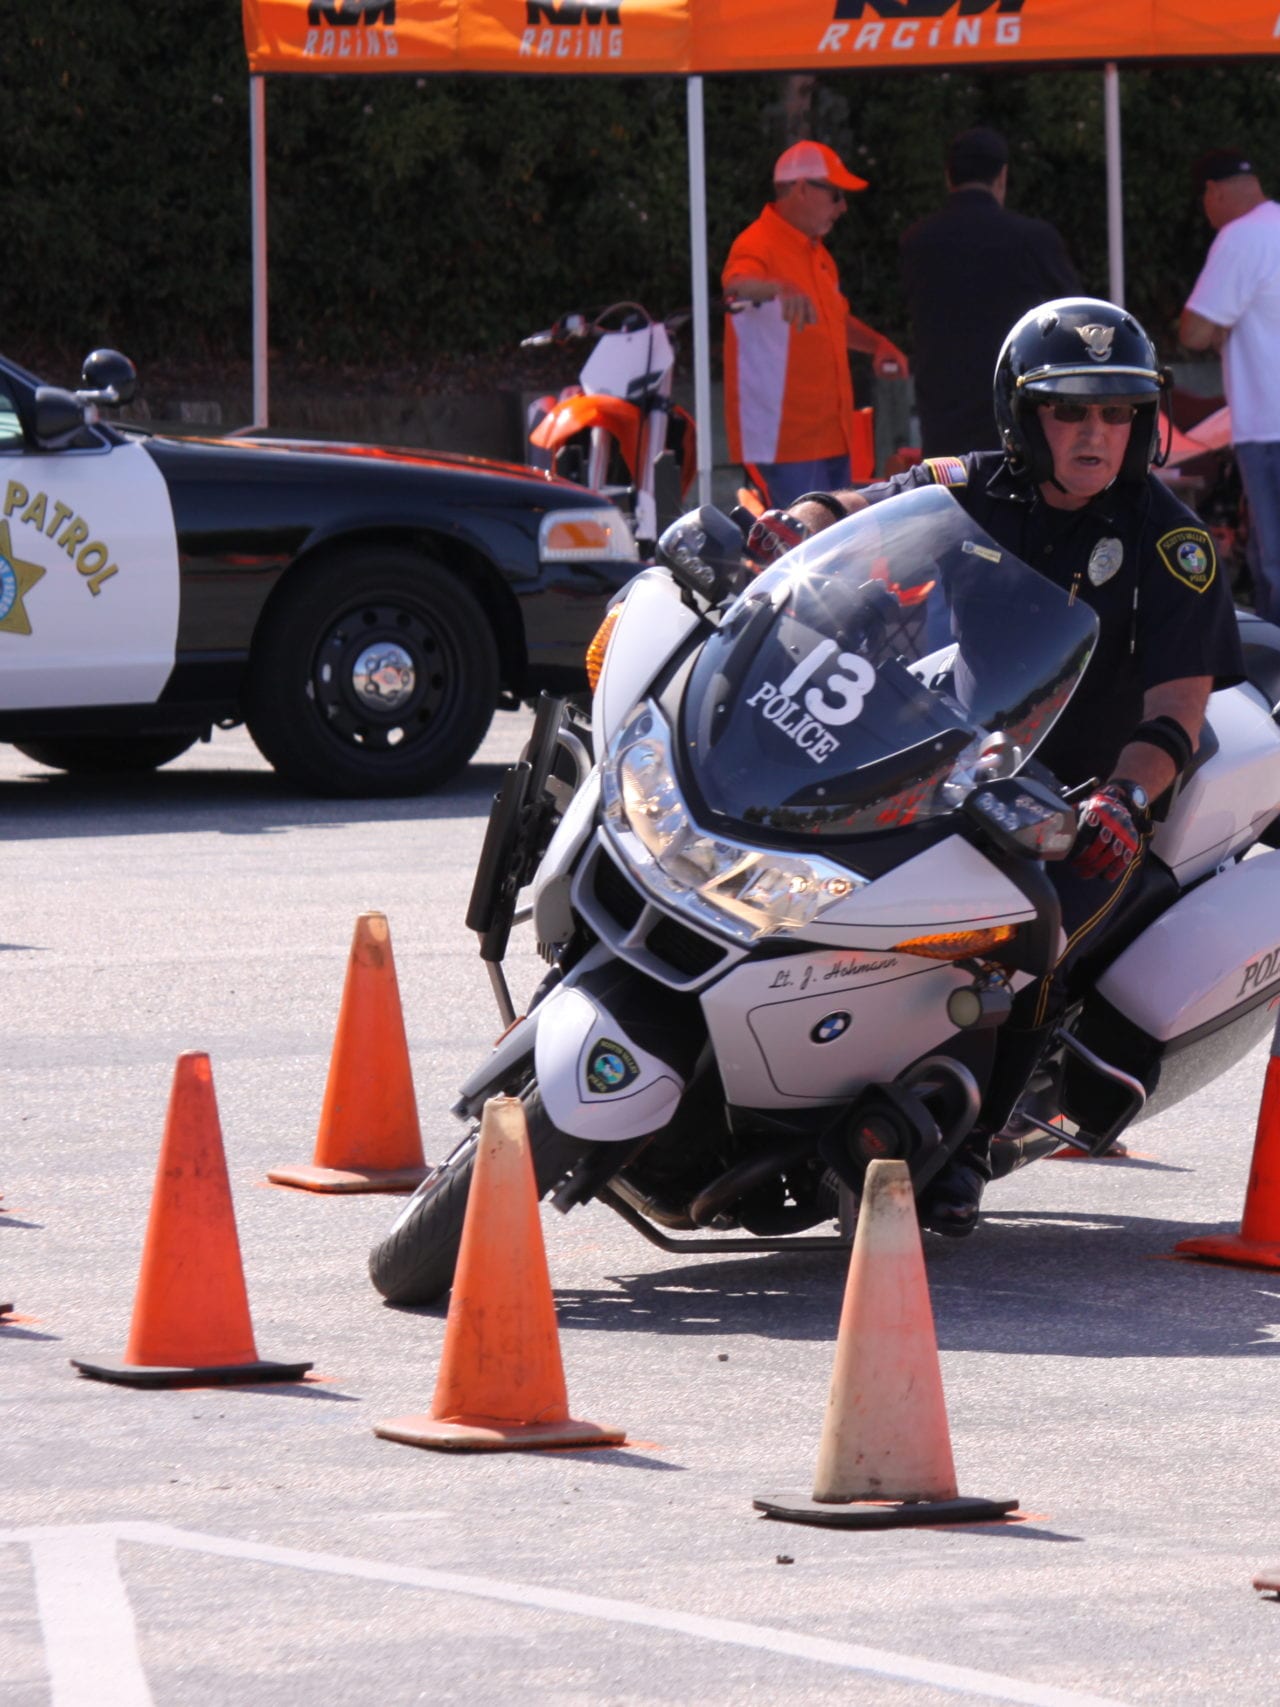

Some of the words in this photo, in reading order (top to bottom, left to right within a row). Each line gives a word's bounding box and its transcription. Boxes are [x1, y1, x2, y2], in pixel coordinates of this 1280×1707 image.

[4, 479, 119, 598] PATROL
[746, 681, 841, 764] POLICE
[779, 638, 876, 726] 13
[768, 969, 793, 989] Lt.
